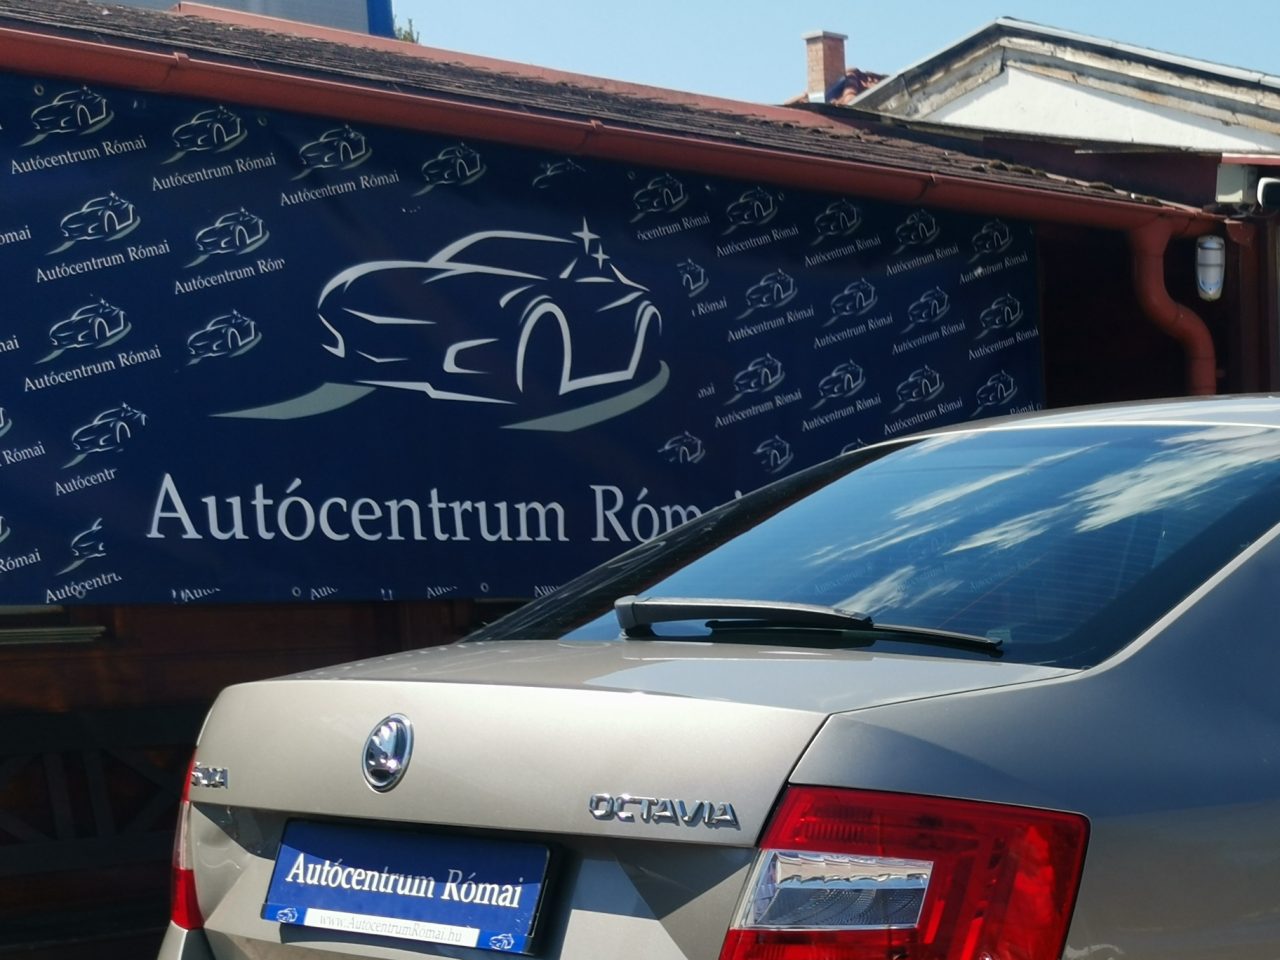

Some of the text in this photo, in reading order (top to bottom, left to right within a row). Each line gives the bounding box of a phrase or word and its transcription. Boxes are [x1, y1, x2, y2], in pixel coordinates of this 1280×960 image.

[11, 135, 147, 175] Autócentrum Római
[152, 152, 277, 191] Autócentrum Római
[280, 170, 400, 206] Autócentrum Római
[681, 212, 711, 231] Római
[716, 226, 799, 258] Autócentrum Római
[36, 240, 171, 283] Autócentrum Római
[174, 264, 256, 295] Autócentrum
[728, 305, 815, 342] Autócentrum Római
[813, 324, 867, 350] Autócentrum
[24, 344, 161, 392] Autócentrum Római
[714, 388, 802, 428] Autócentrum Római
[802, 406, 854, 432] Autócentrum
[3, 441, 46, 465] Római
[146, 472, 569, 542] Autócentrum
[589, 792, 739, 828] OCTAVIA
[285, 852, 525, 918] Autócentrum Római
